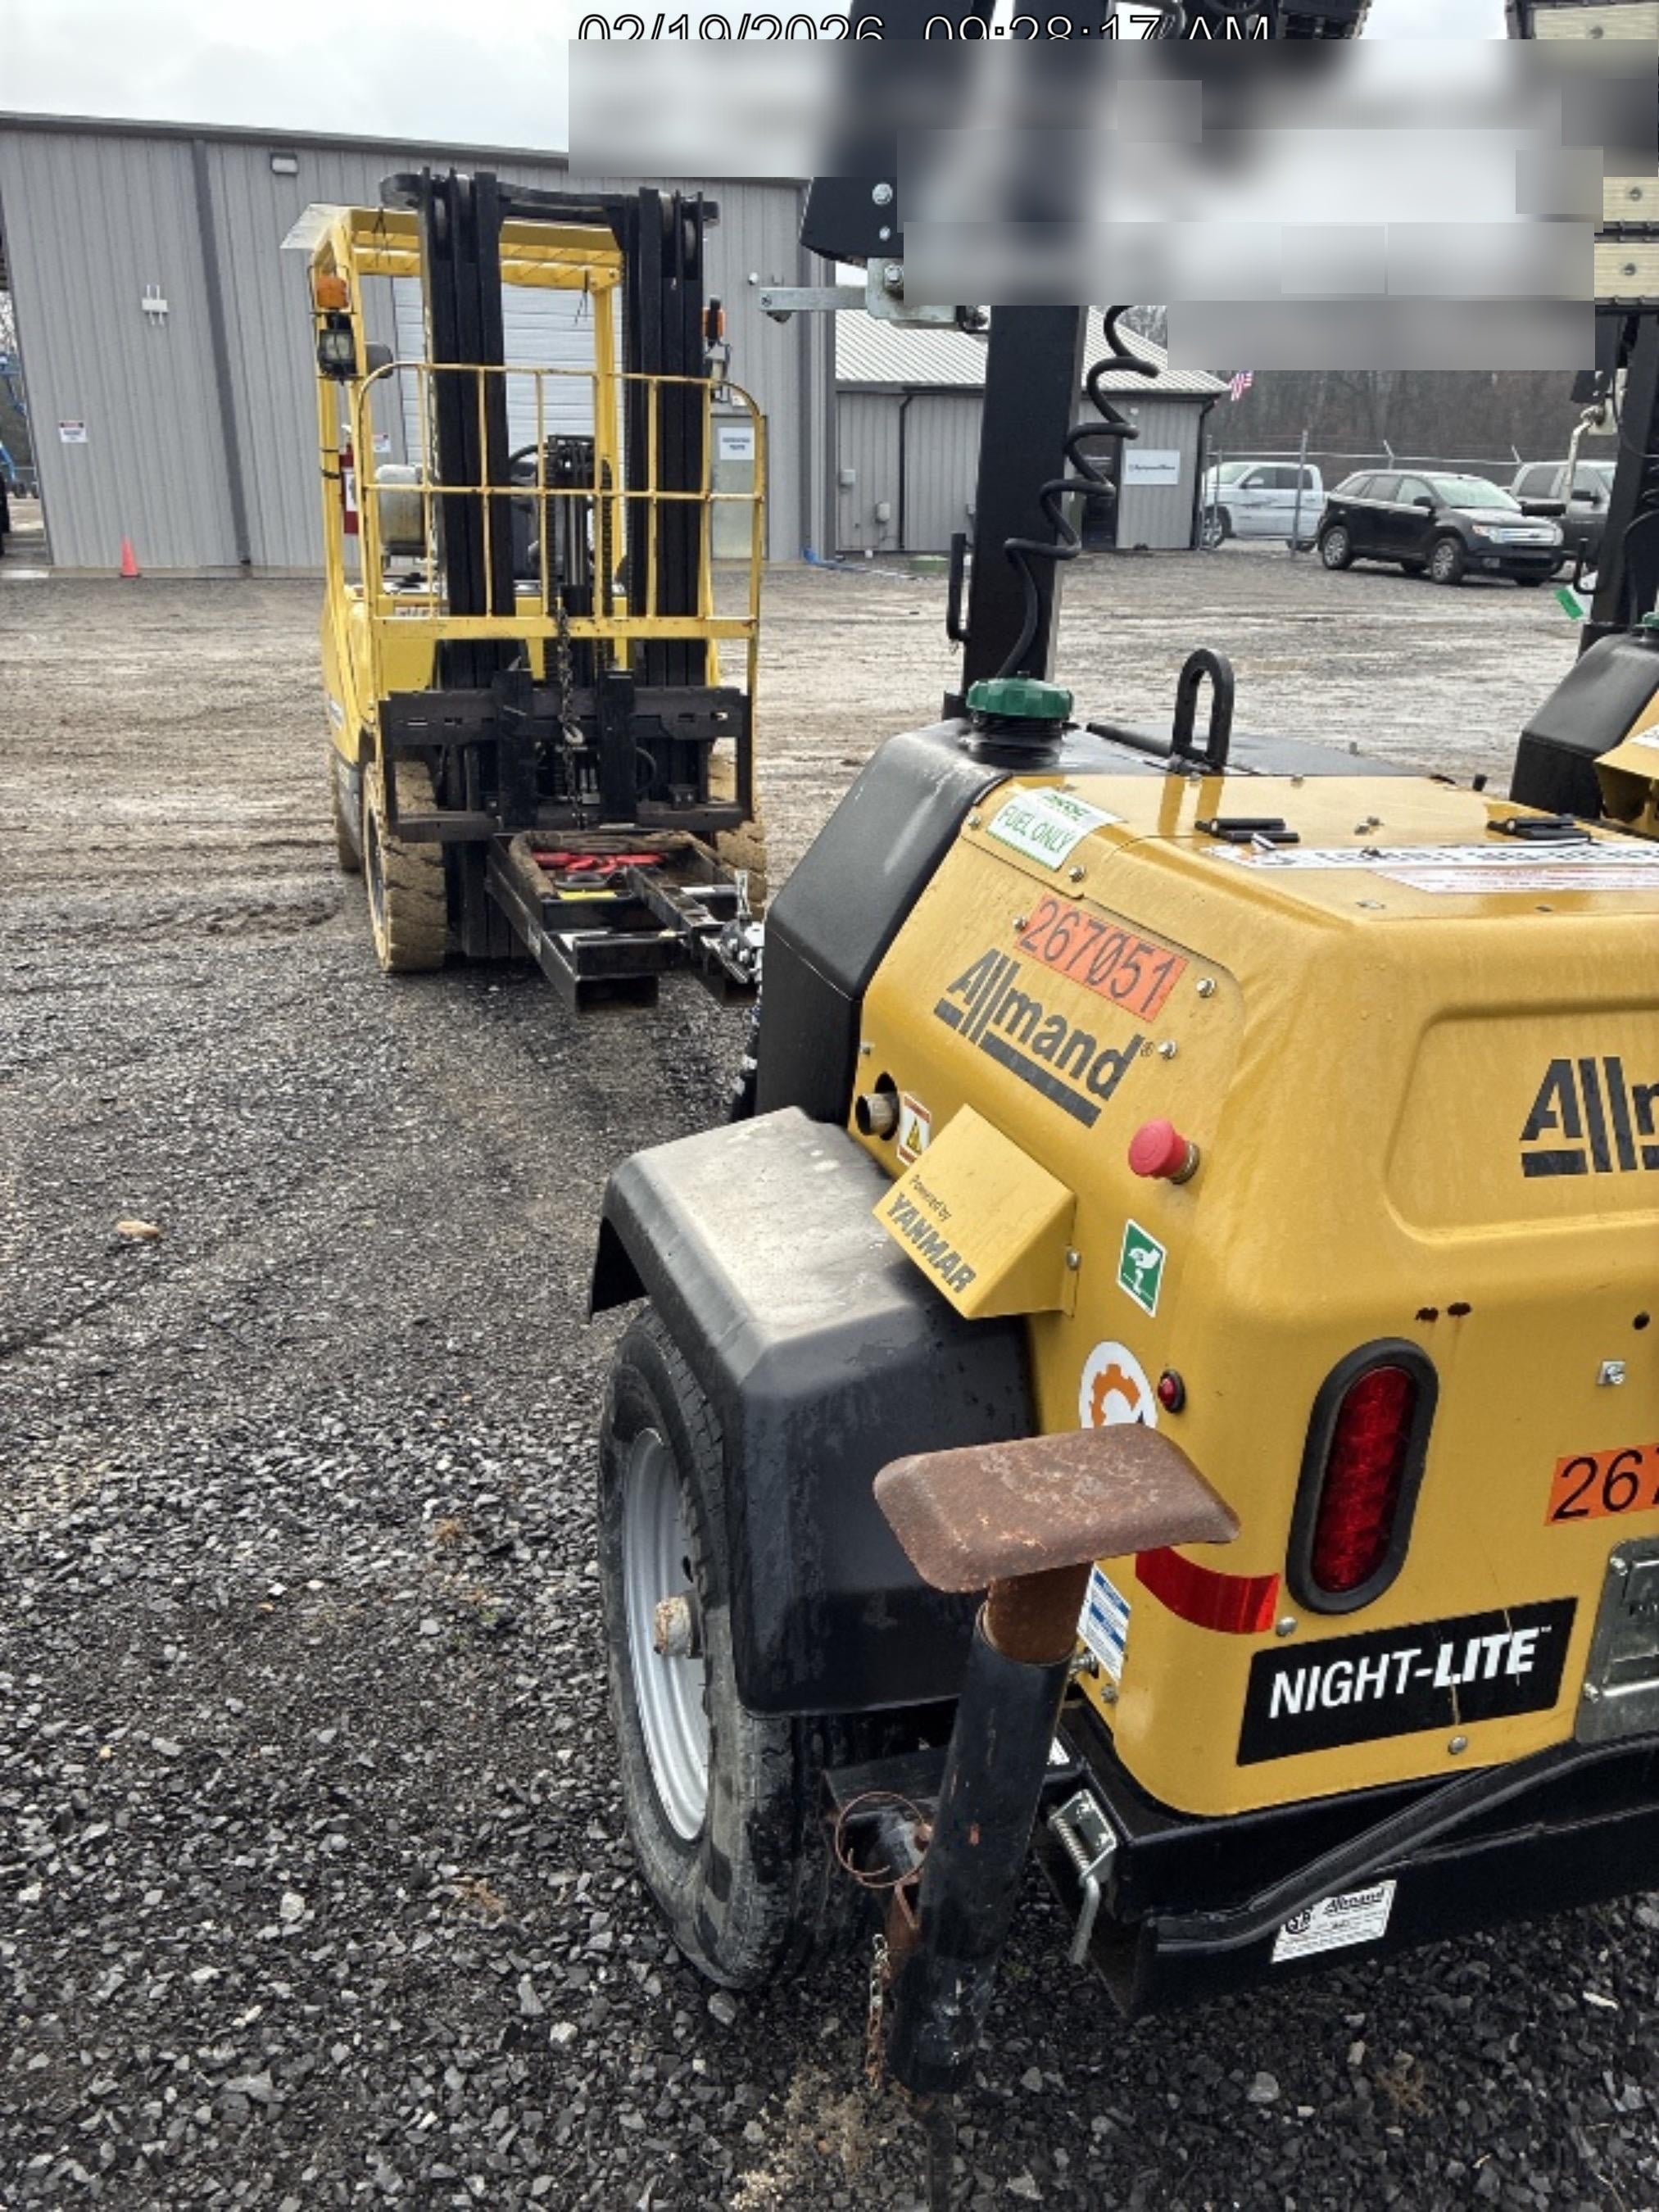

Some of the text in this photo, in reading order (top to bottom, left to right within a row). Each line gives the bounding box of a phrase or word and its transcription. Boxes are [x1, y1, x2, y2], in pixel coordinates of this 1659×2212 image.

[998, 805, 1035, 836] FUEL
[1031, 821, 1076, 854] ONLY
[1019, 899, 1176, 1013] 267051
[886, 1192, 977, 1294] YANMAR
